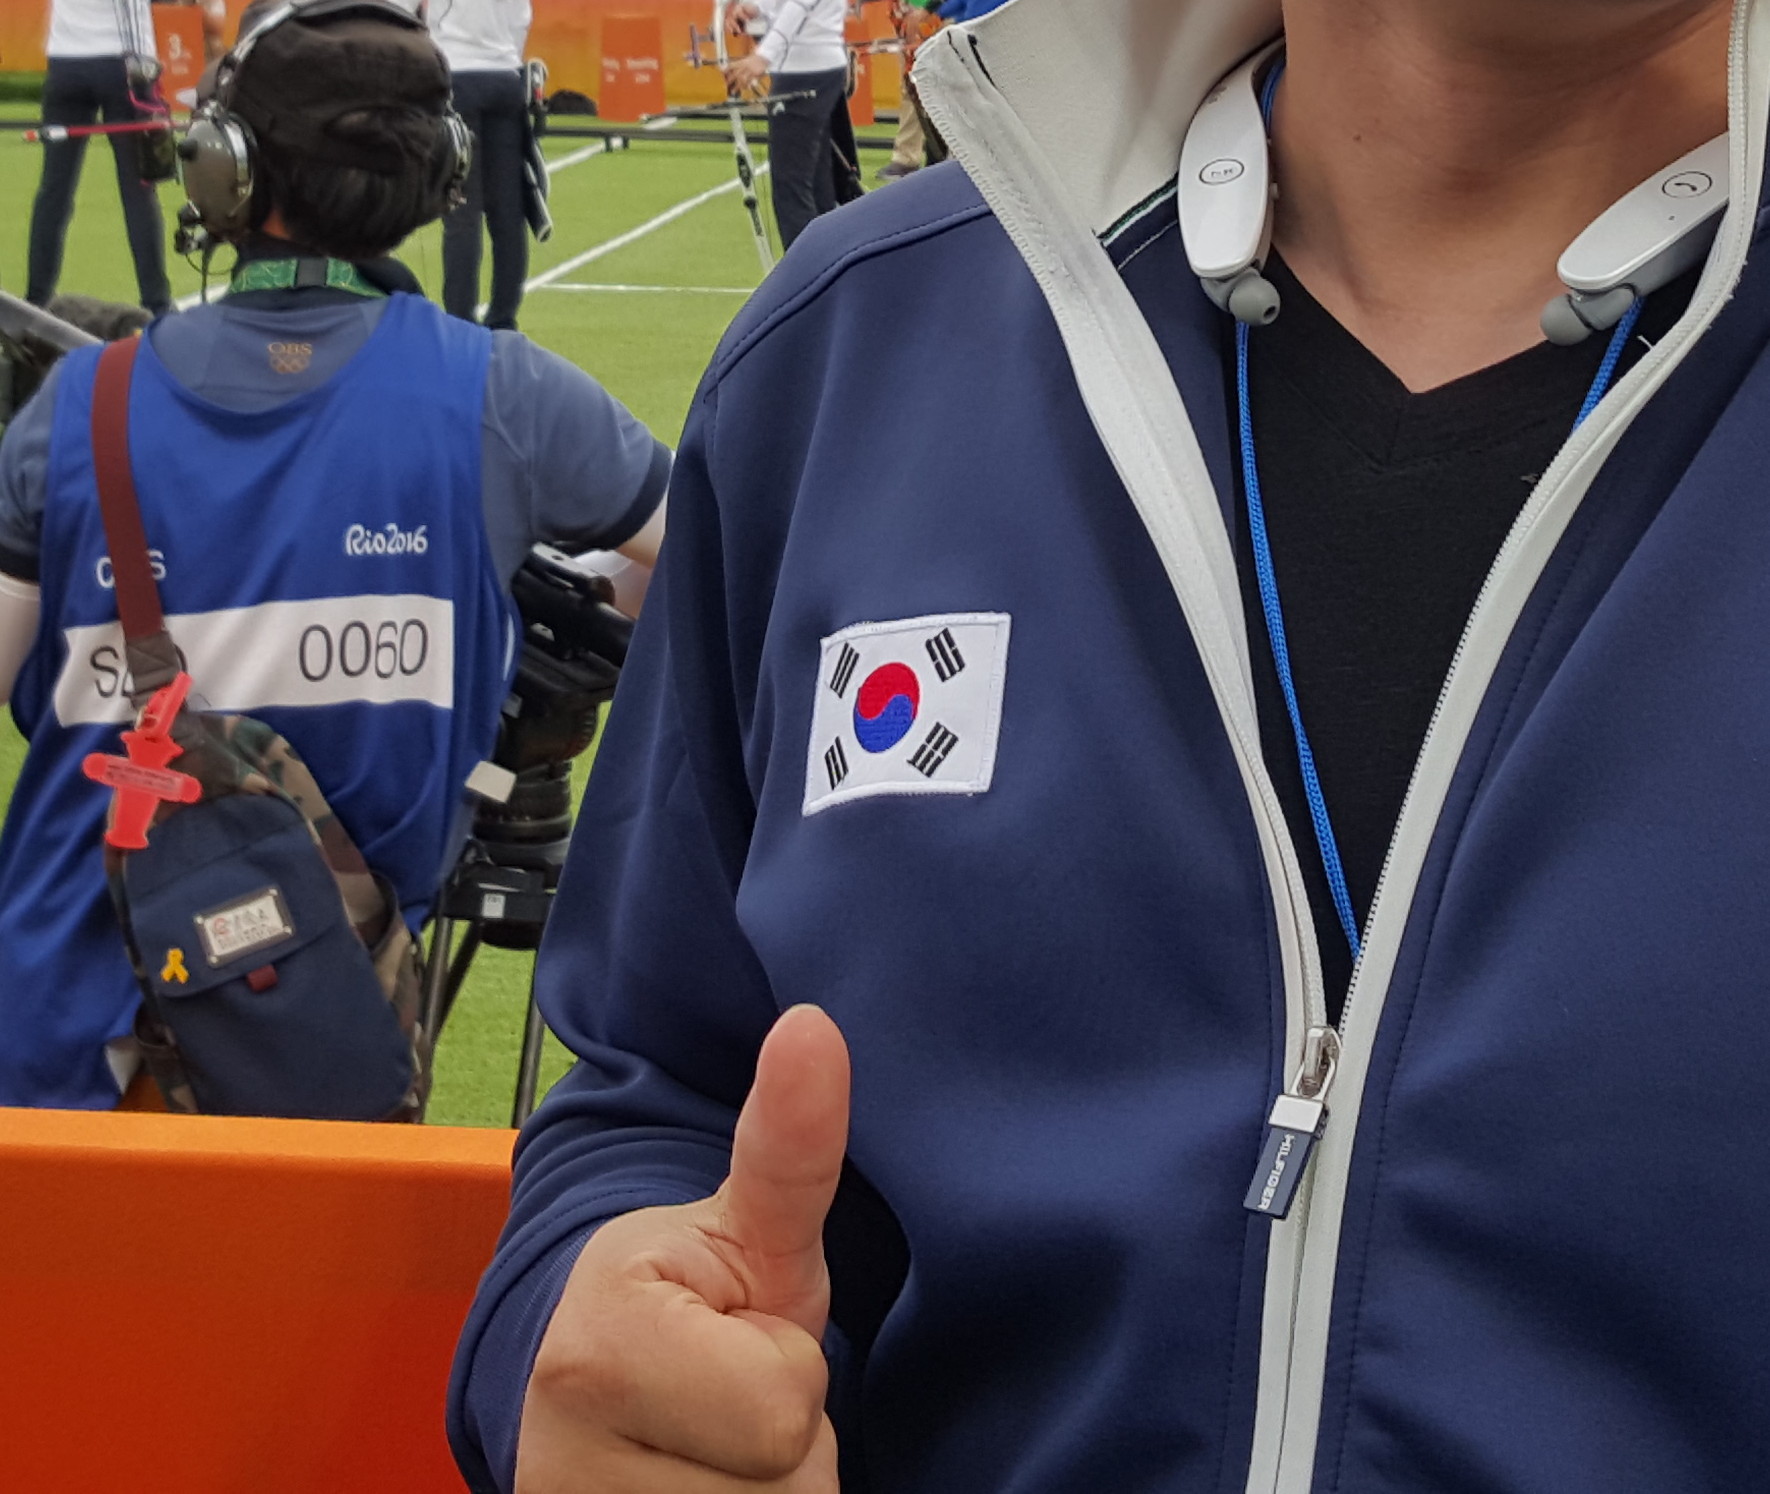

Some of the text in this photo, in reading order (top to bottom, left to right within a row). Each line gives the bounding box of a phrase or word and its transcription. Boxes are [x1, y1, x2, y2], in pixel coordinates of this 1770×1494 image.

[345, 522, 429, 557] Rio2016
[96, 549, 168, 589] OS
[298, 618, 430, 683] 0060
